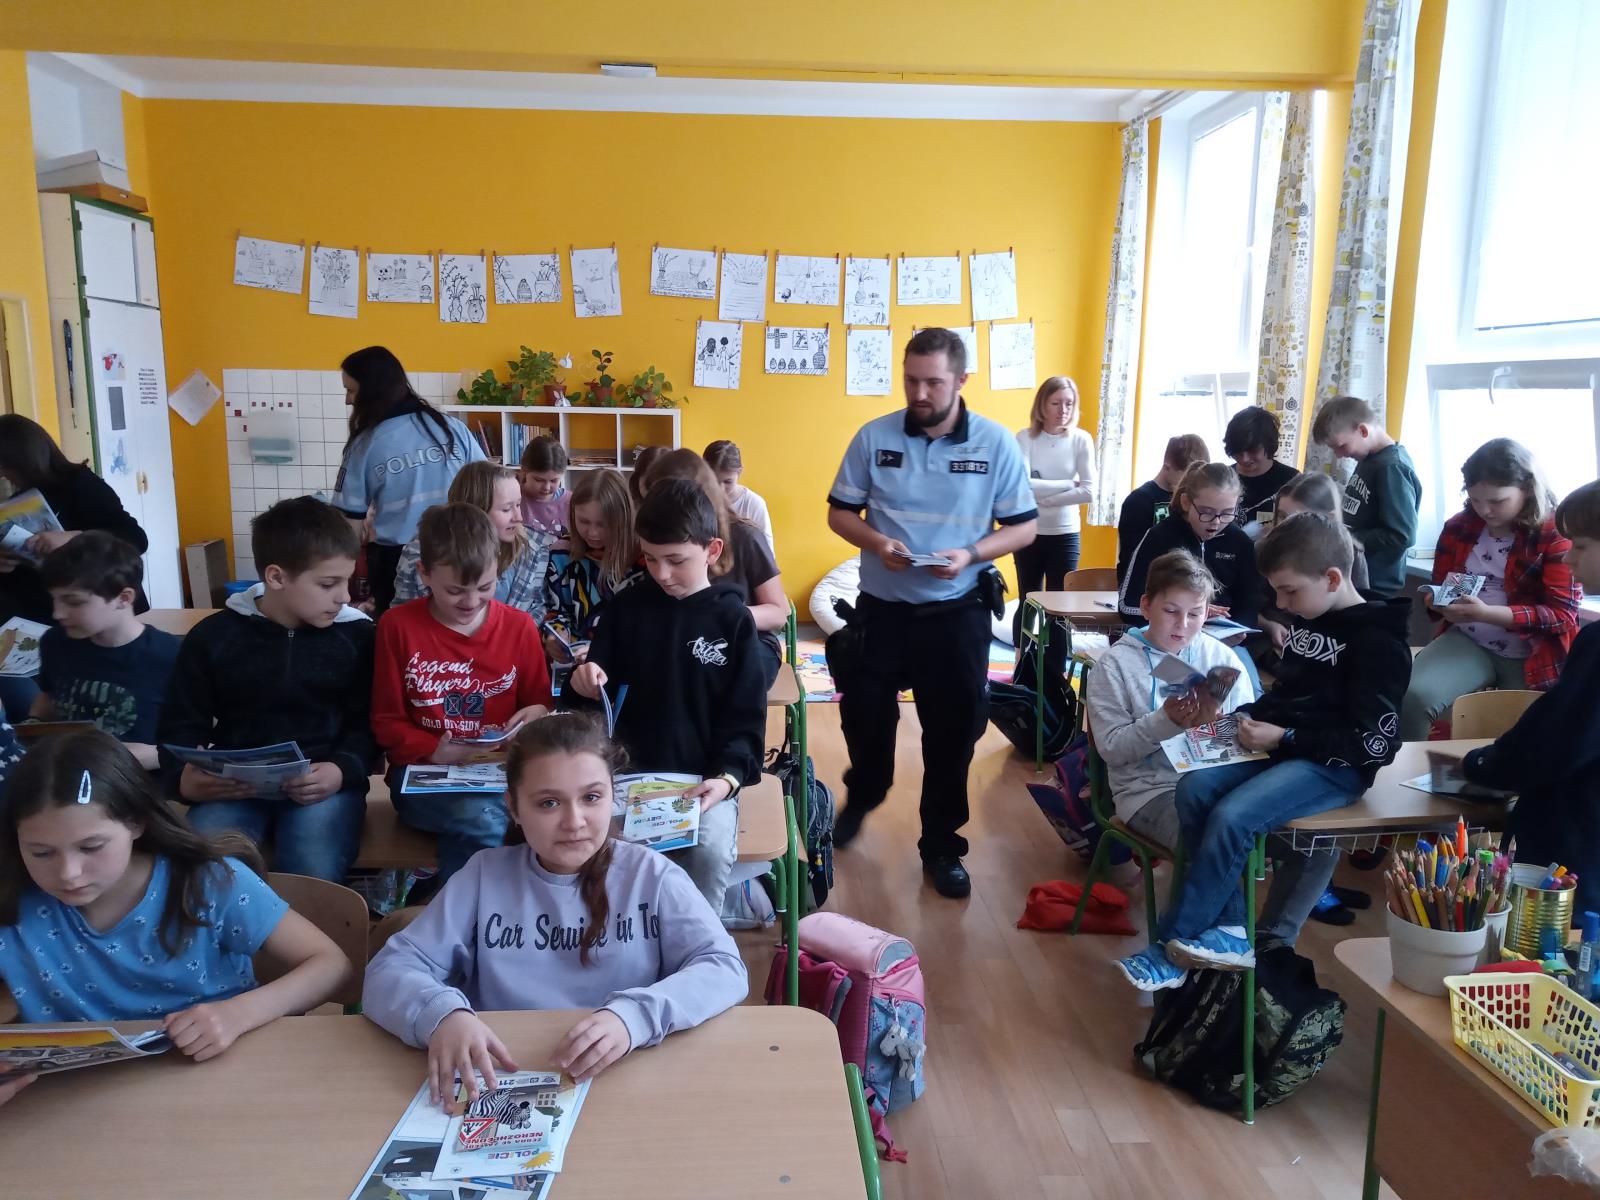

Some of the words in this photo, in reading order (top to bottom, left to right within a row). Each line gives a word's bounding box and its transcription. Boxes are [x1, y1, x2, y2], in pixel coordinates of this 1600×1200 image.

[1283, 625, 1346, 666] XBOX
[405, 652, 474, 680] Legend
[404, 674, 472, 696] Players
[443, 693, 484, 717] 02
[485, 913, 525, 949] Car
[617, 913, 634, 943] in
